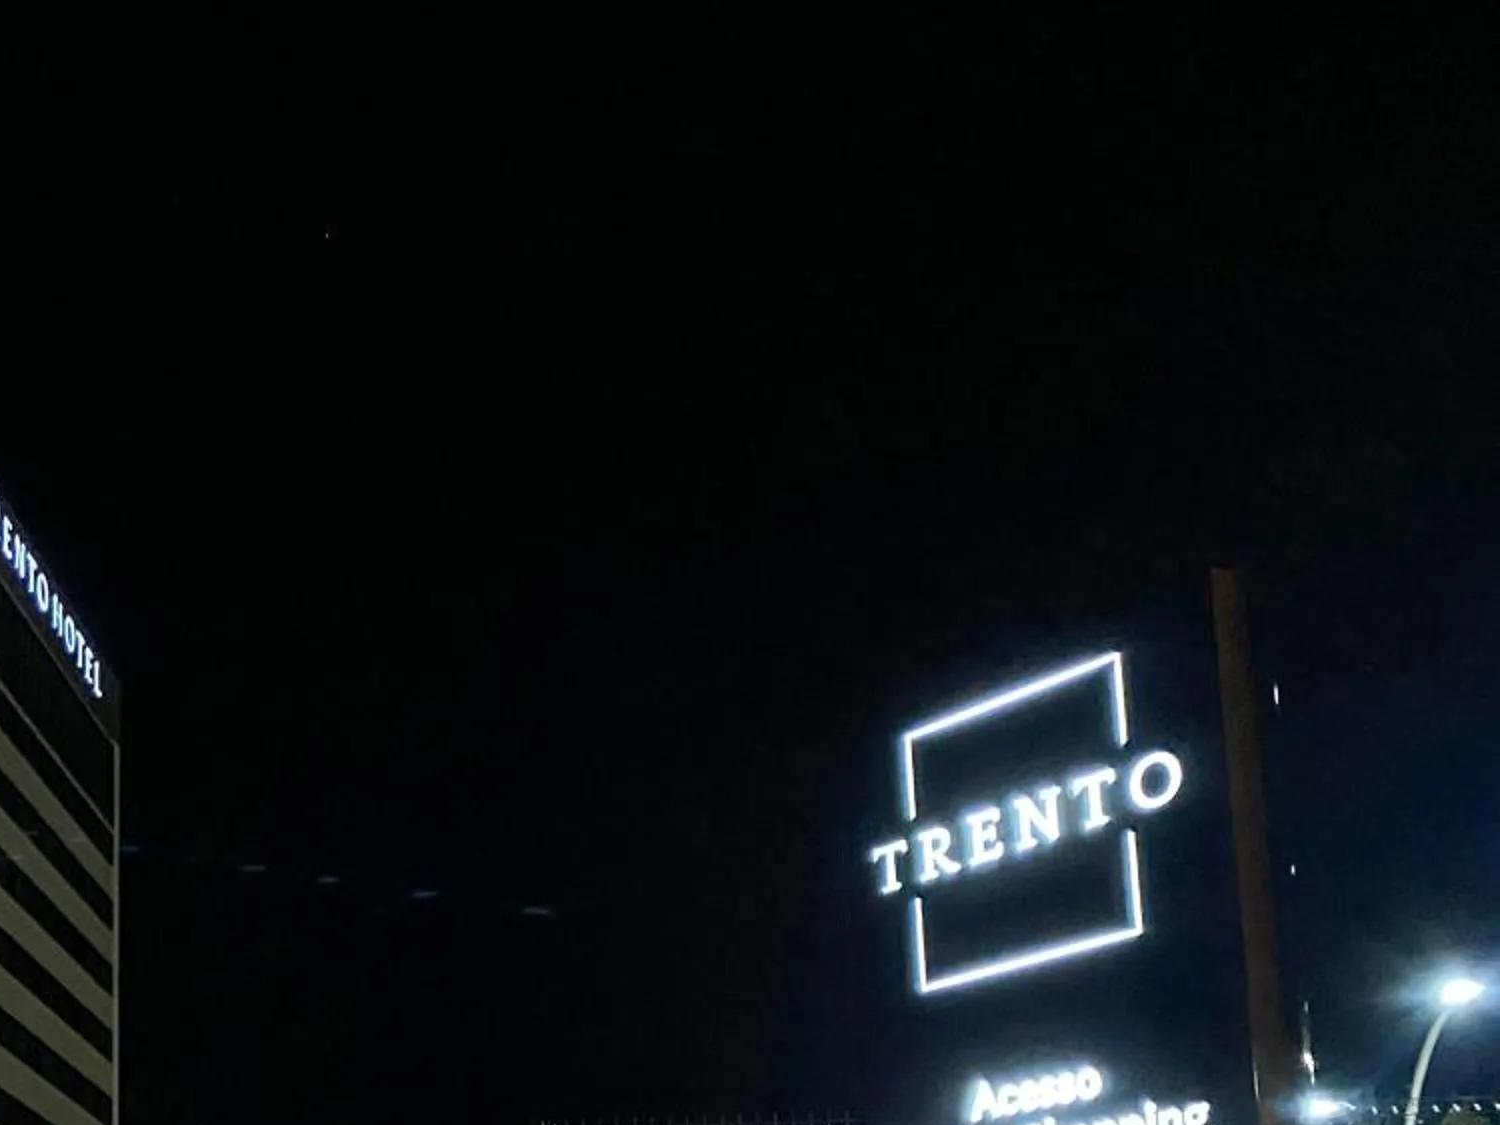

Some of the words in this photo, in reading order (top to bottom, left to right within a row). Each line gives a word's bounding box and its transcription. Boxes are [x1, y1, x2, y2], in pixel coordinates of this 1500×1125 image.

[51, 593, 103, 699] HOTEL
[869, 750, 1184, 896] TRENTO
[971, 1065, 1103, 1123] Acesso
